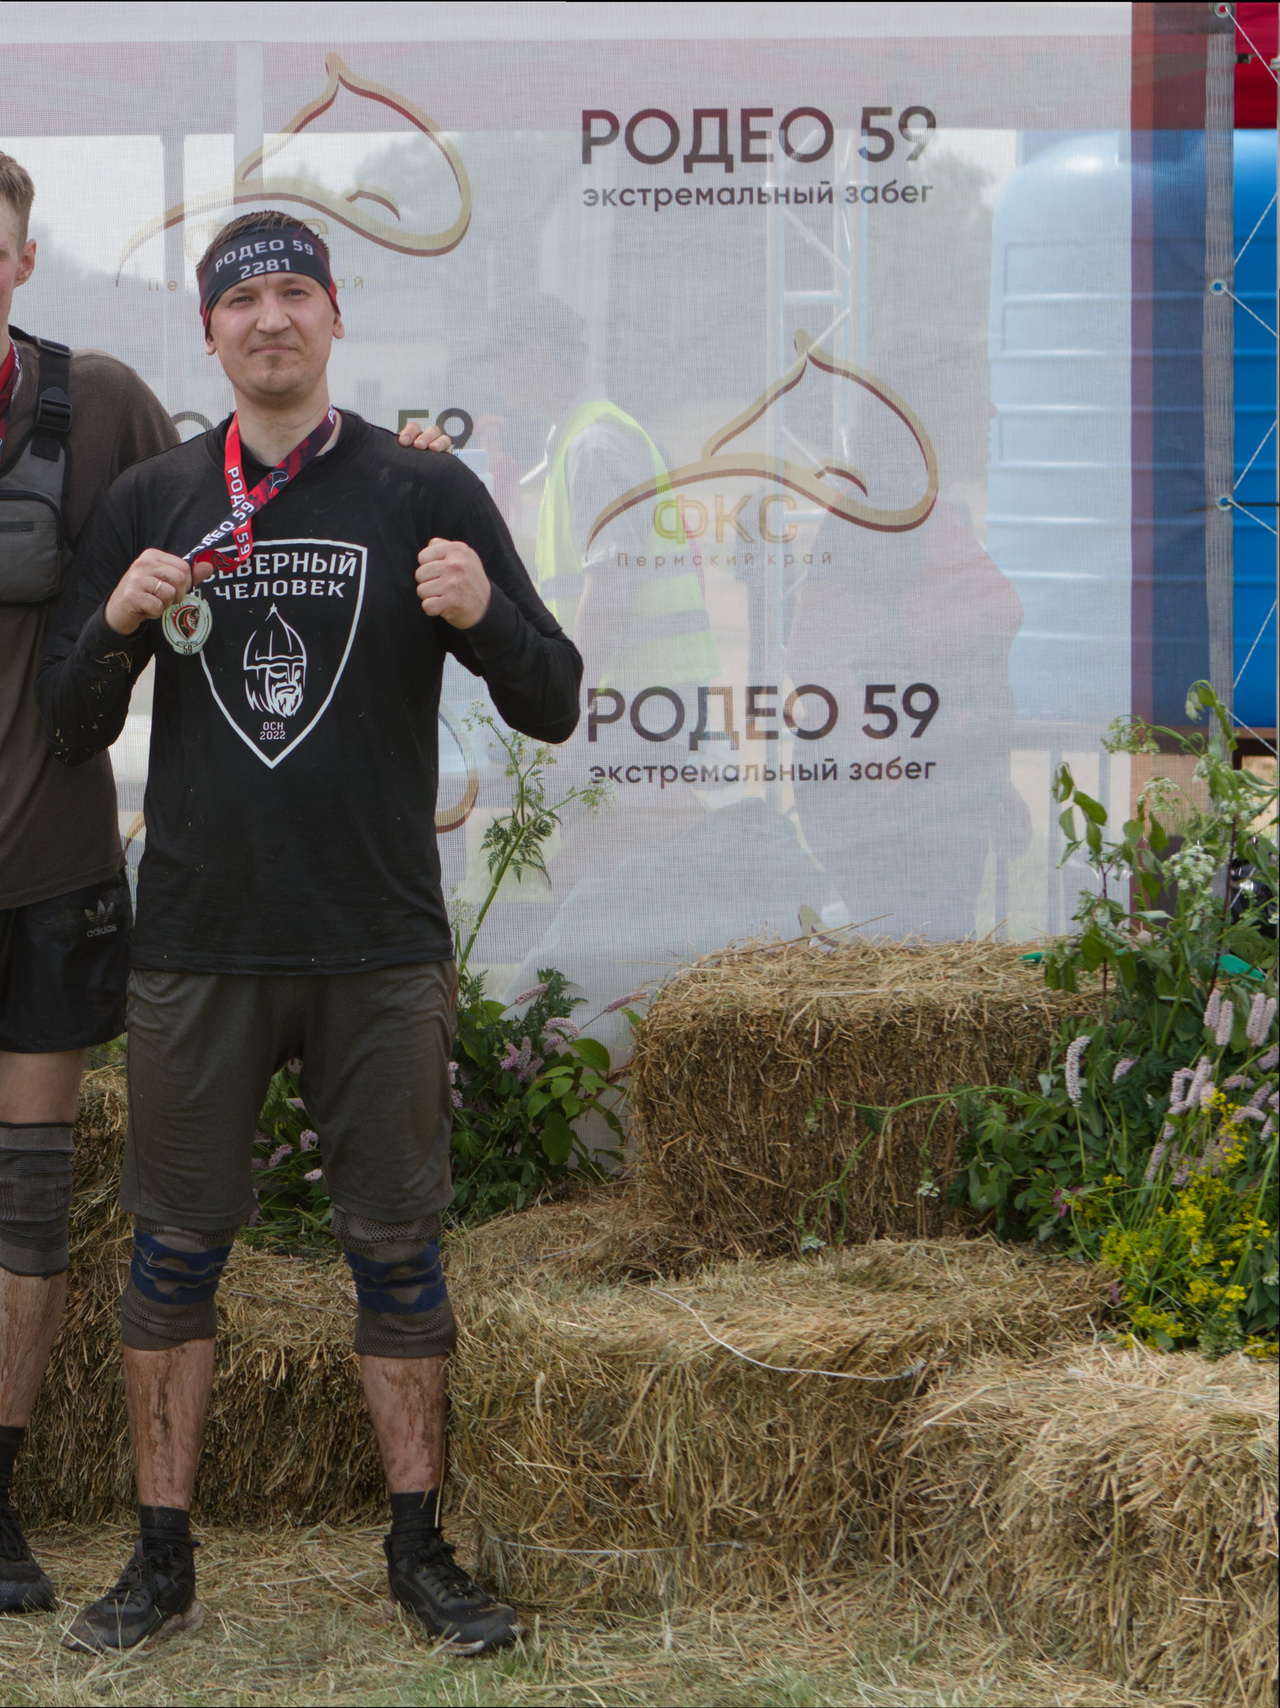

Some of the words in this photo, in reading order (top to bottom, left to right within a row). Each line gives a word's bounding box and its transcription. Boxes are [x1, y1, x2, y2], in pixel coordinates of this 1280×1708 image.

[581, 107, 834, 173] РОДЕО
[858, 106, 937, 162] 59
[583, 181, 834, 211] экстремальный
[845, 179, 933, 206] забег
[215, 239, 285, 273] РОДЕО
[293, 240, 314, 256] 59
[239, 258, 291, 280] 2281
[232, 501, 255, 521] 59
[653, 494, 798, 545] ФКС
[236, 531, 251, 556] 59
[617, 552, 755, 567] Пермский
[768, 550, 832, 567] край
[214, 579, 346, 601] ЧЕЛОВЕК
[182, 644, 193, 655] 59
[587, 683, 839, 751] РОДЕО
[861, 682, 940, 740] 59
[259, 730, 286, 740] 2022
[588, 758, 838, 789] экстремальный
[849, 755, 936, 782] забег
